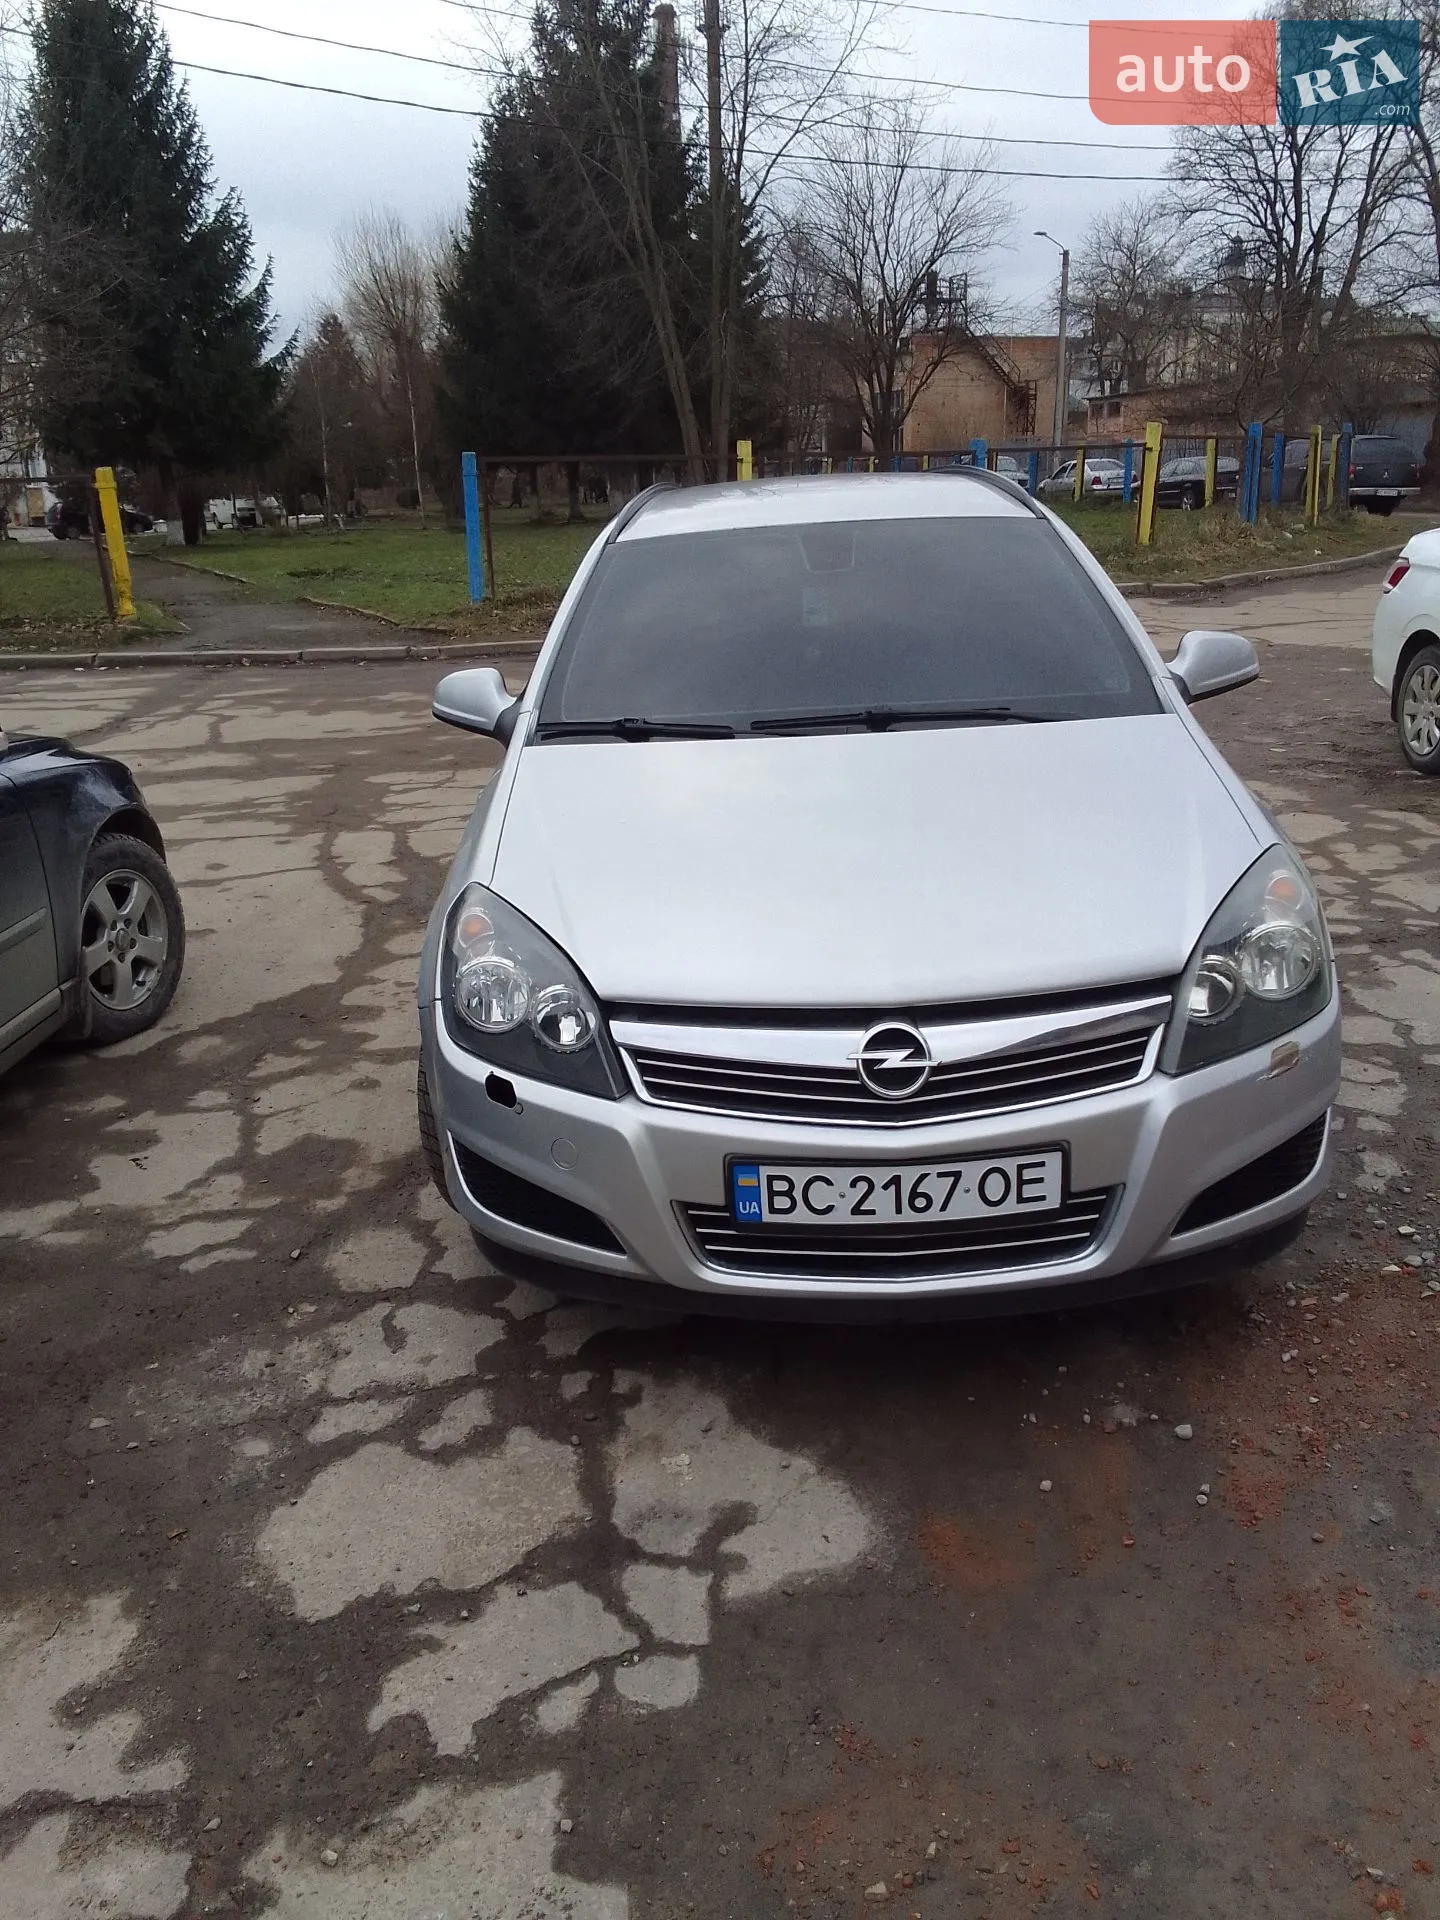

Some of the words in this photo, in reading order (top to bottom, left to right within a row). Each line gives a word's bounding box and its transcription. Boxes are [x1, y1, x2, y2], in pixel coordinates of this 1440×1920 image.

[766, 1174, 835, 1216] BC
[849, 1170, 963, 1216] 2167
[977, 1160, 1048, 1208] OE
[738, 1201, 760, 1214] UA
